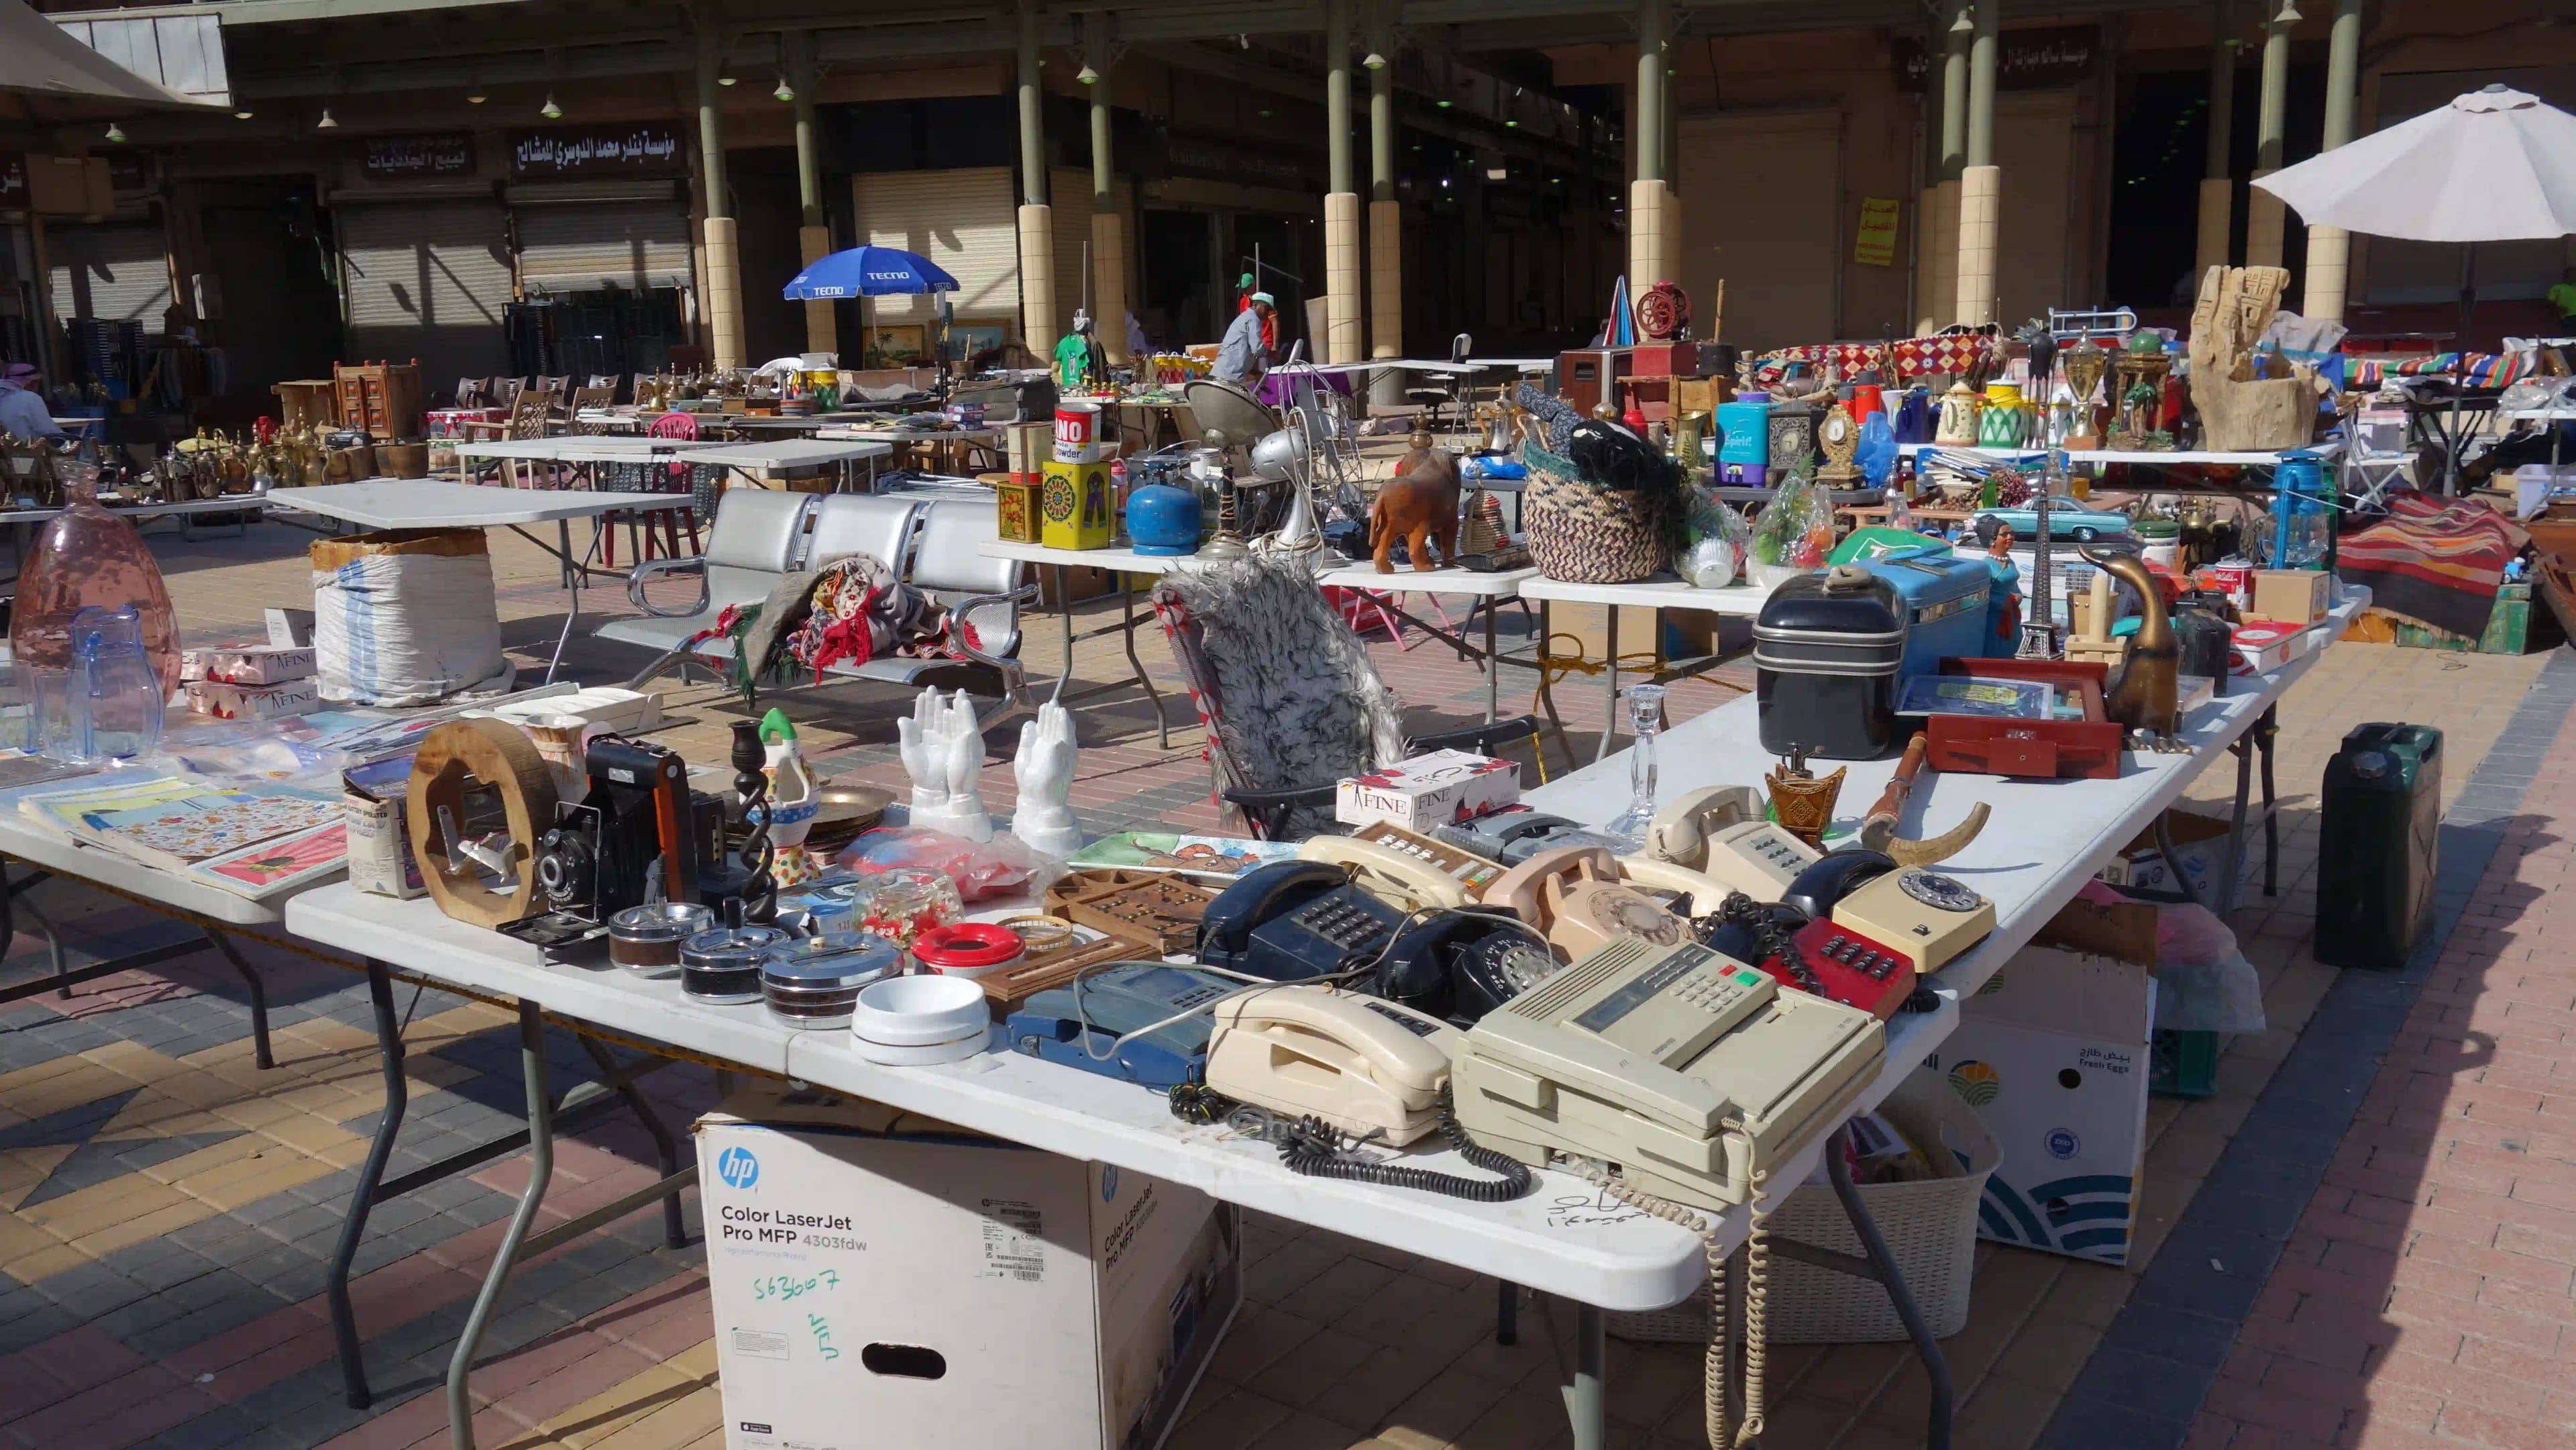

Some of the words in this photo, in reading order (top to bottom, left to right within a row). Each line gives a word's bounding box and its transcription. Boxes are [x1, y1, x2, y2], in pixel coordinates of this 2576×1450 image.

[555, 137, 594, 170] الدوسري
[596, 138, 620, 158] محمد
[621, 133, 643, 165] بندر
[644, 130, 675, 161] مؤسسة
[867, 271, 910, 280] TECNO
[813, 287, 844, 296] TECNO
[284, 653, 314, 666] FINE
[280, 690, 315, 707] FINE
[1364, 793, 1407, 814] FINE
[1418, 788, 1451, 809] FINE
[2080, 1048, 2102, 1057] طازج
[2103, 1051, 2131, 1064] بيض
[2080, 1058, 2104, 1069] Fresh
[2106, 1062, 2129, 1074] Eggs
[723, 1147, 755, 1188] hp
[721, 1206, 770, 1223] Color
[775, 1210, 853, 1231] LaserJet
[1104, 1220, 1124, 1253] Color
[1124, 1182, 1152, 1227] LaserJet
[722, 1225, 753, 1241] Pro
[759, 1227, 797, 1244] MFP
[802, 1234, 867, 1252] 4303fdw
[1105, 1251, 1118, 1274] Pro
[1119, 1226, 1134, 1255] MFP
